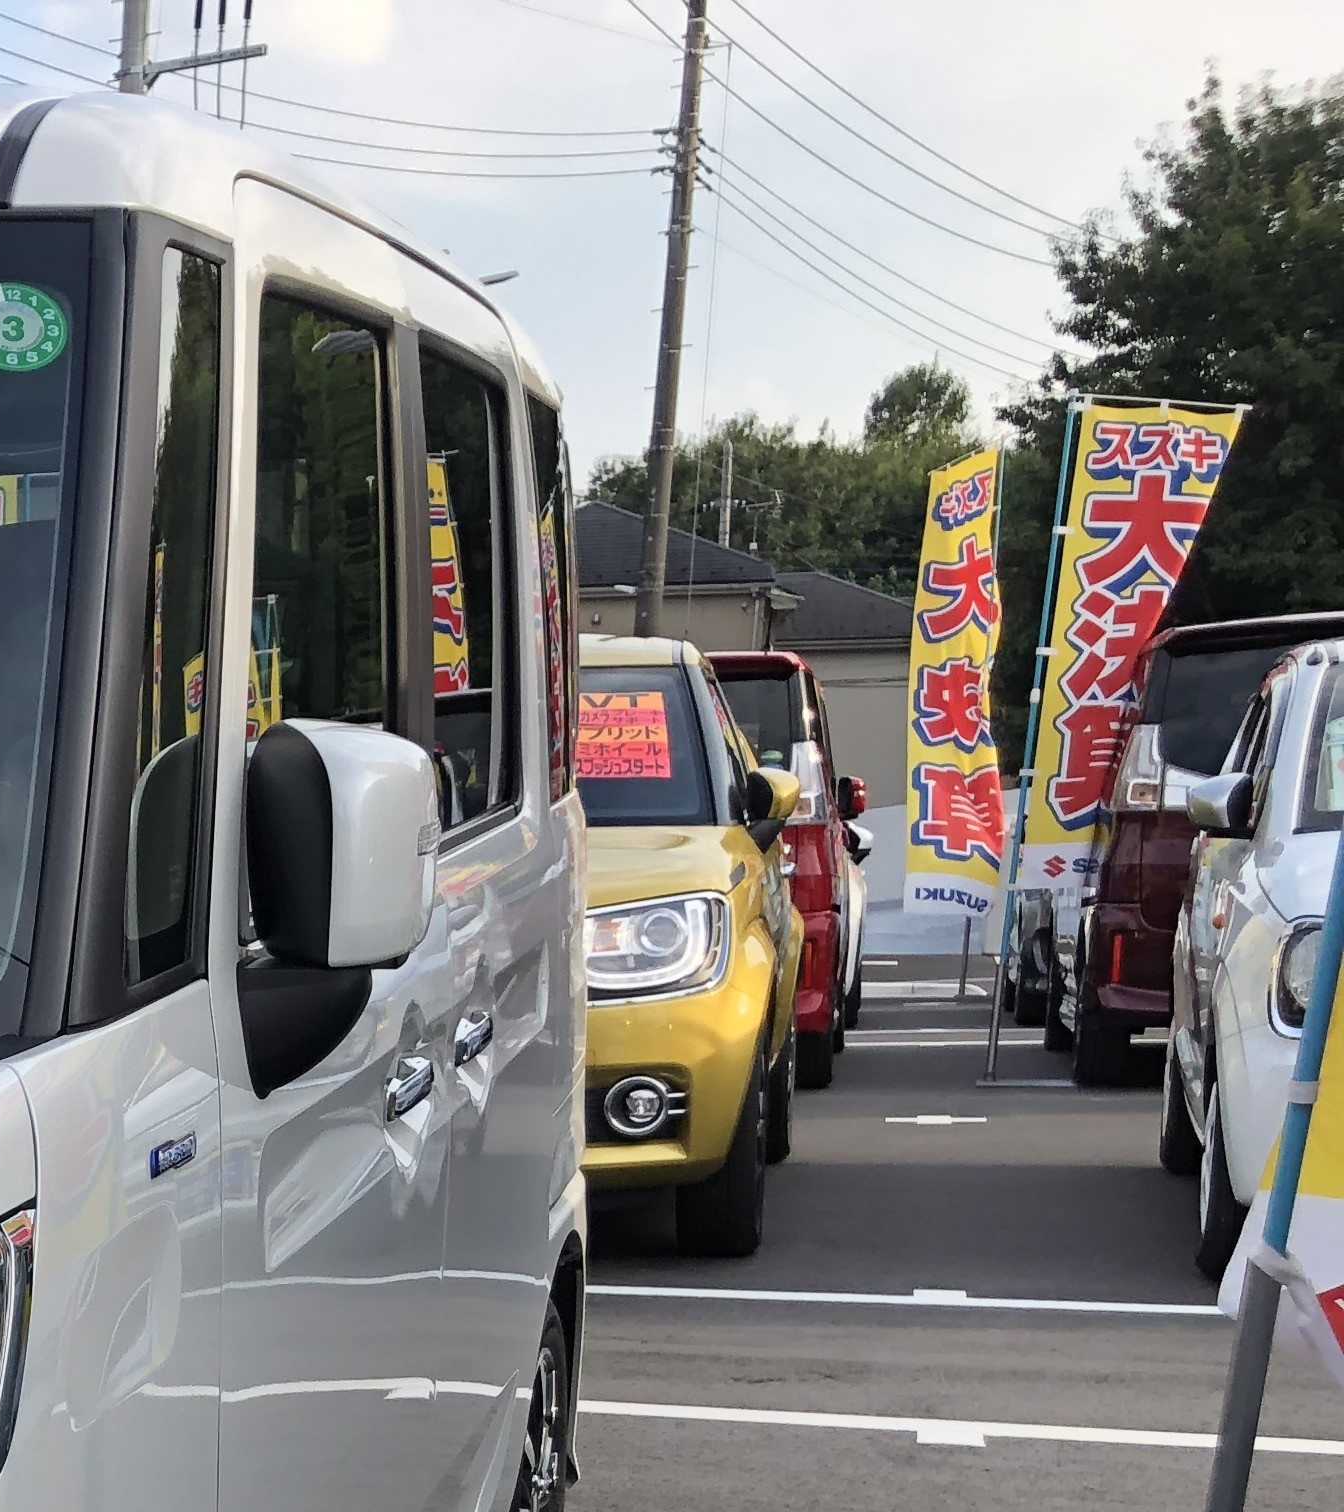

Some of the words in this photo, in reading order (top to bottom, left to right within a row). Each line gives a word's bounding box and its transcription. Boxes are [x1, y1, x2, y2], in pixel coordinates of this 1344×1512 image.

[6, 289, 22, 301] 12
[29, 295, 38, 307] 1
[42, 308, 56, 320] 2
[1, 315, 25, 343] 3
[47, 324, 60, 337] 3
[40, 340, 54, 353] 4
[5, 352, 19, 365] 6
[25, 351, 39, 363] 5
[1088, 421, 1225, 472] スズキ
